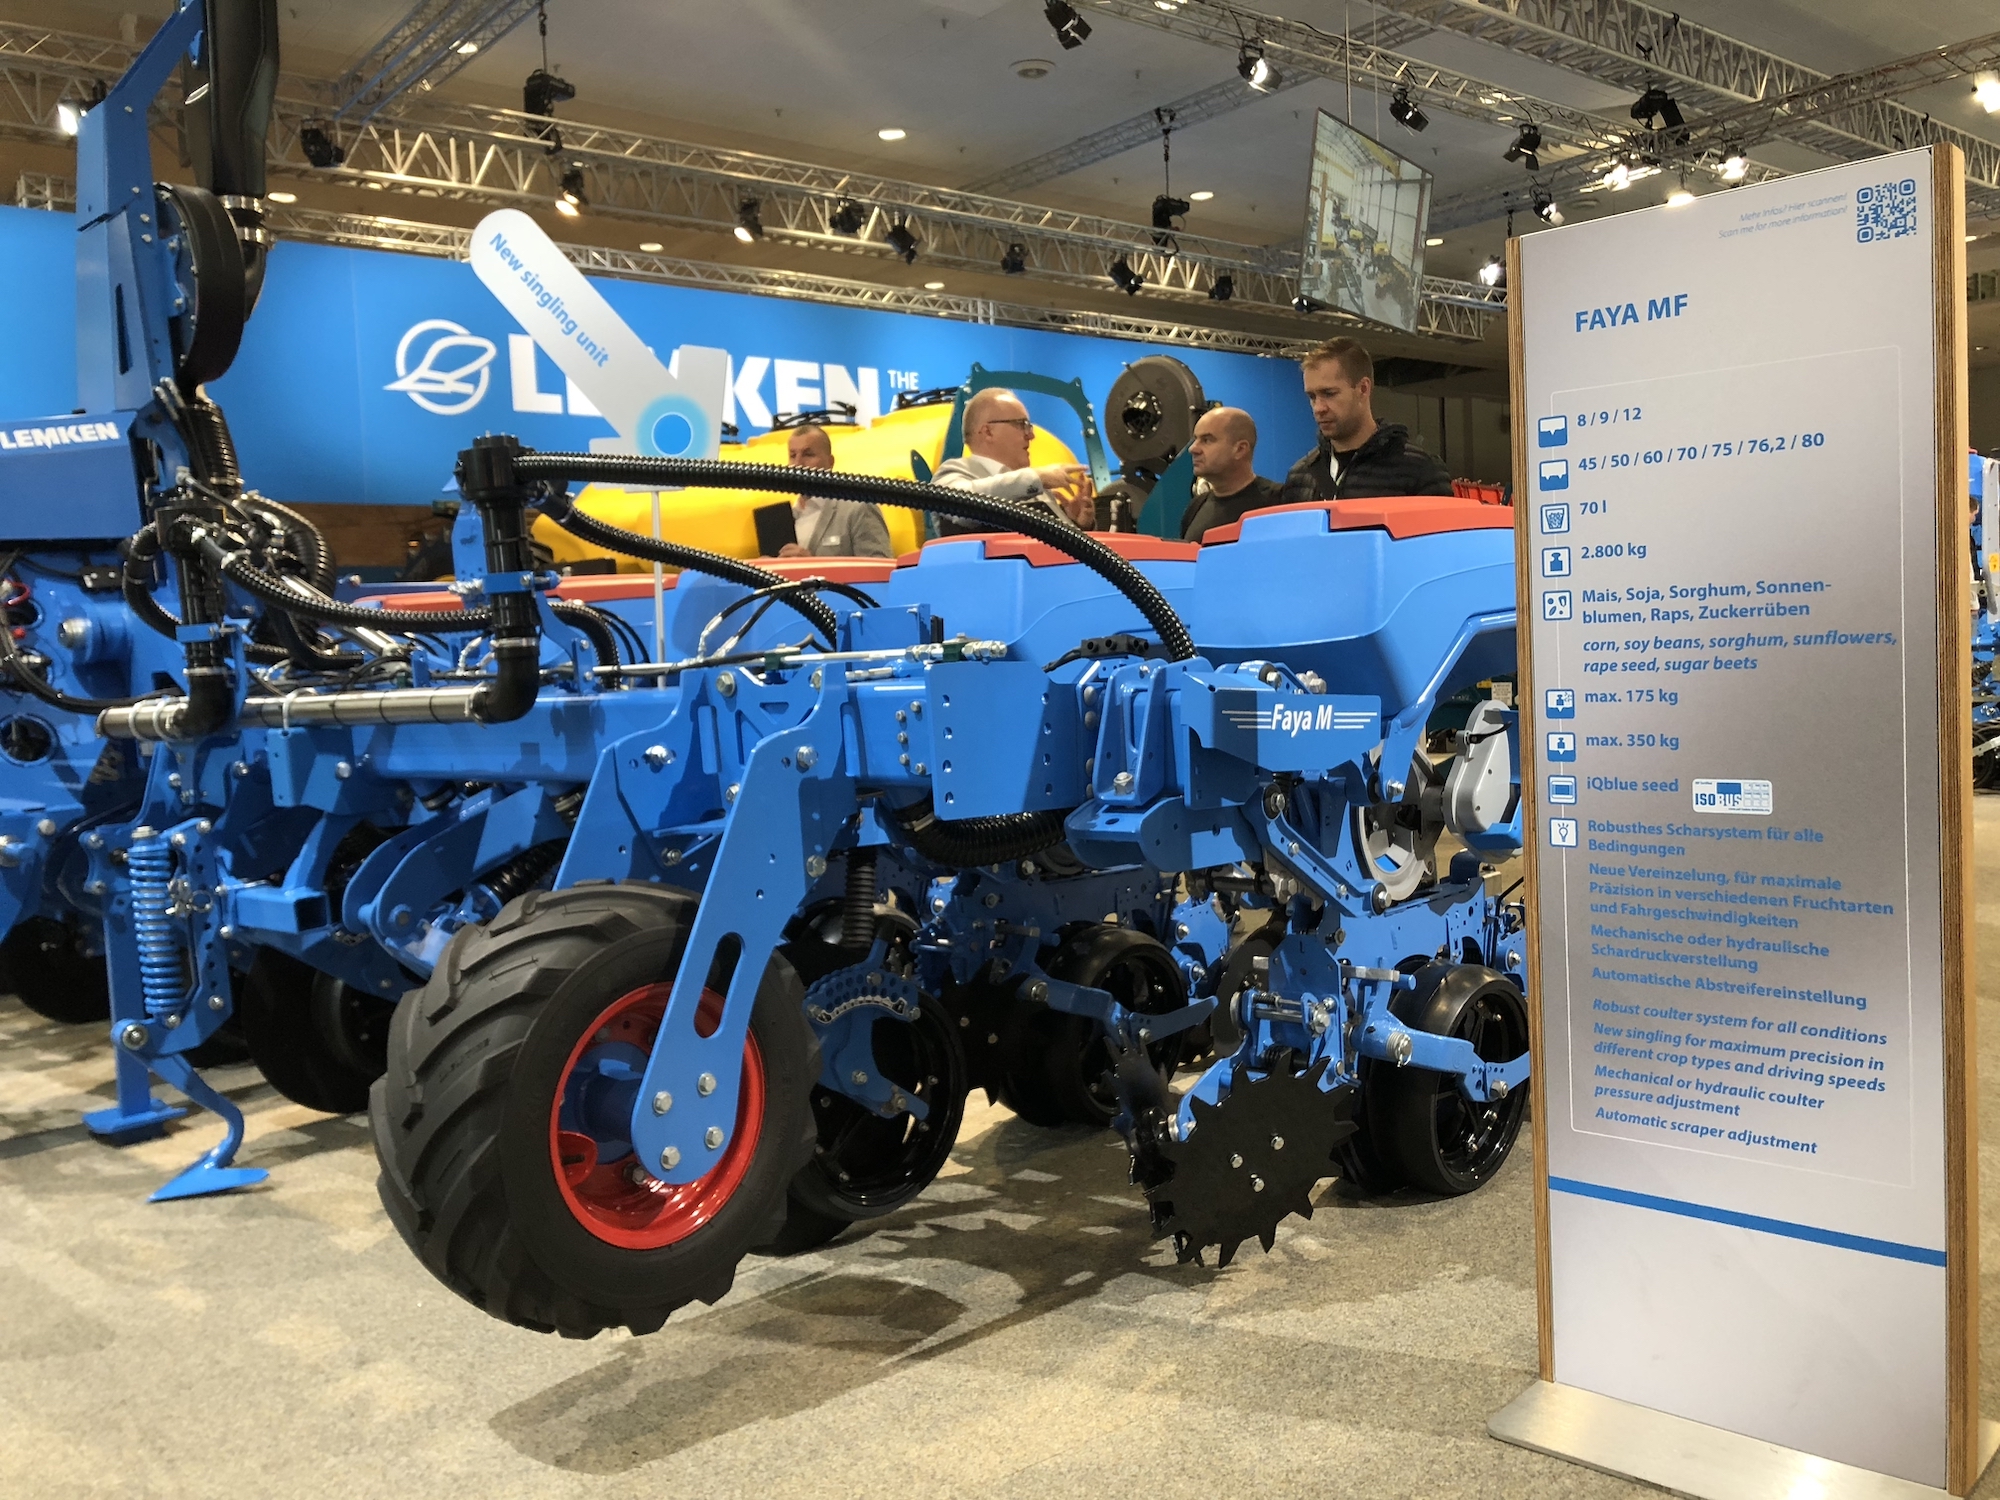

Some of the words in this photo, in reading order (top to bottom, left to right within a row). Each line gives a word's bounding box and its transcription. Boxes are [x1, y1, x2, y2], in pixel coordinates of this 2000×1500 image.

[1788, 201, 1806, 212] Hier
[1718, 228, 1739, 239] Scan
[1740, 225, 1754, 233] me
[1755, 222, 1768, 231] for
[1768, 217, 1791, 229] more
[489, 233, 523, 271] New
[520, 270, 578, 336] singling
[576, 331, 609, 367] unit
[1575, 302, 1640, 333] FAYA
[1647, 293, 1689, 322] MF
[508, 333, 881, 428] LKEN
[887, 370, 919, 390] THE
[1577, 414, 1587, 427] 8
[1591, 412, 1597, 426] /
[1599, 411, 1610, 424] 9
[1613, 409, 1619, 423] /
[1623, 407, 1642, 421] 12
[0, 421, 119, 449] LEMKEN
[1578, 457, 1598, 471] 45
[1601, 456, 1608, 469] /
[1611, 453, 1631, 468] 50
[1633, 452, 1640, 466] /
[1642, 450, 1664, 465] 60
[1667, 448, 1674, 463] /
[1677, 446, 1698, 461] 70
[1701, 445, 1708, 459] /
[1712, 442, 1733, 457] 75
[1737, 441, 1744, 455] /
[1748, 436, 1786, 454] 76,2
[1790, 435, 1797, 450] /
[1801, 432, 1826, 449] 80
[1580, 501, 1598, 515] 70
[1602, 500, 1607, 513] l
[1582, 544, 1624, 560] 2.800
[1627, 542, 1648, 560] kg
[1582, 589, 1622, 603] Mais,
[1626, 587, 1665, 604] Soja,
[1669, 583, 1751, 602] Sorghum,
[1756, 580, 1832, 595] Sonnen-
[1582, 610, 1647, 625] blumen,
[1651, 608, 1694, 624] Raps,
[1699, 603, 1810, 619] Zuckerrüben
[1583, 641, 1620, 653] corn,
[1624, 640, 1650, 653] soy
[1653, 637, 1705, 651] beans,
[1710, 634, 1788, 652] sorghum,
[1793, 630, 1897, 646] sunflowers,
[1583, 662, 1618, 675] rape
[1621, 658, 1660, 673] seed,
[1665, 660, 1710, 675] sugar
[1713, 656, 1758, 671] beets
[1584, 692, 1622, 703] max.
[1627, 689, 1655, 703] 175
[1658, 688, 1679, 707] kg
[1271, 703, 1312, 738] Faya
[1315, 704, 1333, 730] M
[1586, 736, 1623, 747] max.
[1627, 733, 1657, 747] 350
[1659, 734, 1680, 751] kg
[1586, 776, 1637, 792] iQblue
[1642, 779, 1680, 793] seed
[1588, 820, 1663, 836] Robusthes
[1666, 823, 1763, 841] Scharsystem
[1766, 827, 1790, 841] für
[1793, 828, 1824, 843] alle
[1588, 839, 1685, 857] Bedingungen
[1589, 863, 1625, 877] Neue
[1628, 865, 1729, 885] Vereinzelung,
[1734, 871, 1756, 884] für
[1760, 876, 1842, 891] maximale
[1589, 881, 1654, 897] Präzision
[1658, 887, 1671, 899] in
[1675, 890, 1788, 907] verschiedenen
[1793, 896, 1894, 915] Fruchtarten
[1590, 902, 1618, 914] und
[1621, 903, 1798, 928] Fahrgeschwindigkeiten
[1590, 924, 1683, 944] Mechanische
[1688, 932, 1722, 947] oder
[1727, 935, 1829, 957] hydraulische
[1591, 943, 1758, 973] Schardruckverstellung
[1592, 967, 1692, 989] Automatische
[1695, 978, 1868, 1011] Abstreifereinstellung
[1592, 998, 1640, 1015] Robust
[1643, 1006, 1693, 1022] coulter
[1695, 1013, 1748, 1028] system
[1751, 1017, 1774, 1031] for
[1777, 1021, 1798, 1034] all
[1800, 1026, 1887, 1046] conditions
[1593, 1022, 1623, 1037] New
[1626, 1029, 1682, 1047] singling
[1685, 1034, 1706, 1047] for
[1710, 1040, 1786, 1057] maximum
[1790, 1051, 1864, 1068] precision
[1868, 1058, 1885, 1071] in
[1594, 1041, 1653, 1059] different
[1656, 1052, 1688, 1067] crop
[1692, 1056, 1730, 1070] types
[1735, 1063, 1765, 1074] and
[1768, 1065, 1824, 1086] driving
[1829, 1076, 1886, 1092] speeds
[1594, 1065, 1674, 1086] Mechanical
[1676, 1078, 1691, 1089] or
[1696, 1079, 1765, 1102] hydraulic
[1768, 1093, 1824, 1109] coulter
[1594, 1086, 1653, 1102] pressure
[1656, 1095, 1740, 1116] adjustment
[1595, 1107, 1667, 1129] Automatic
[1670, 1122, 1725, 1138] scraper
[1727, 1130, 1818, 1154] adjustment
